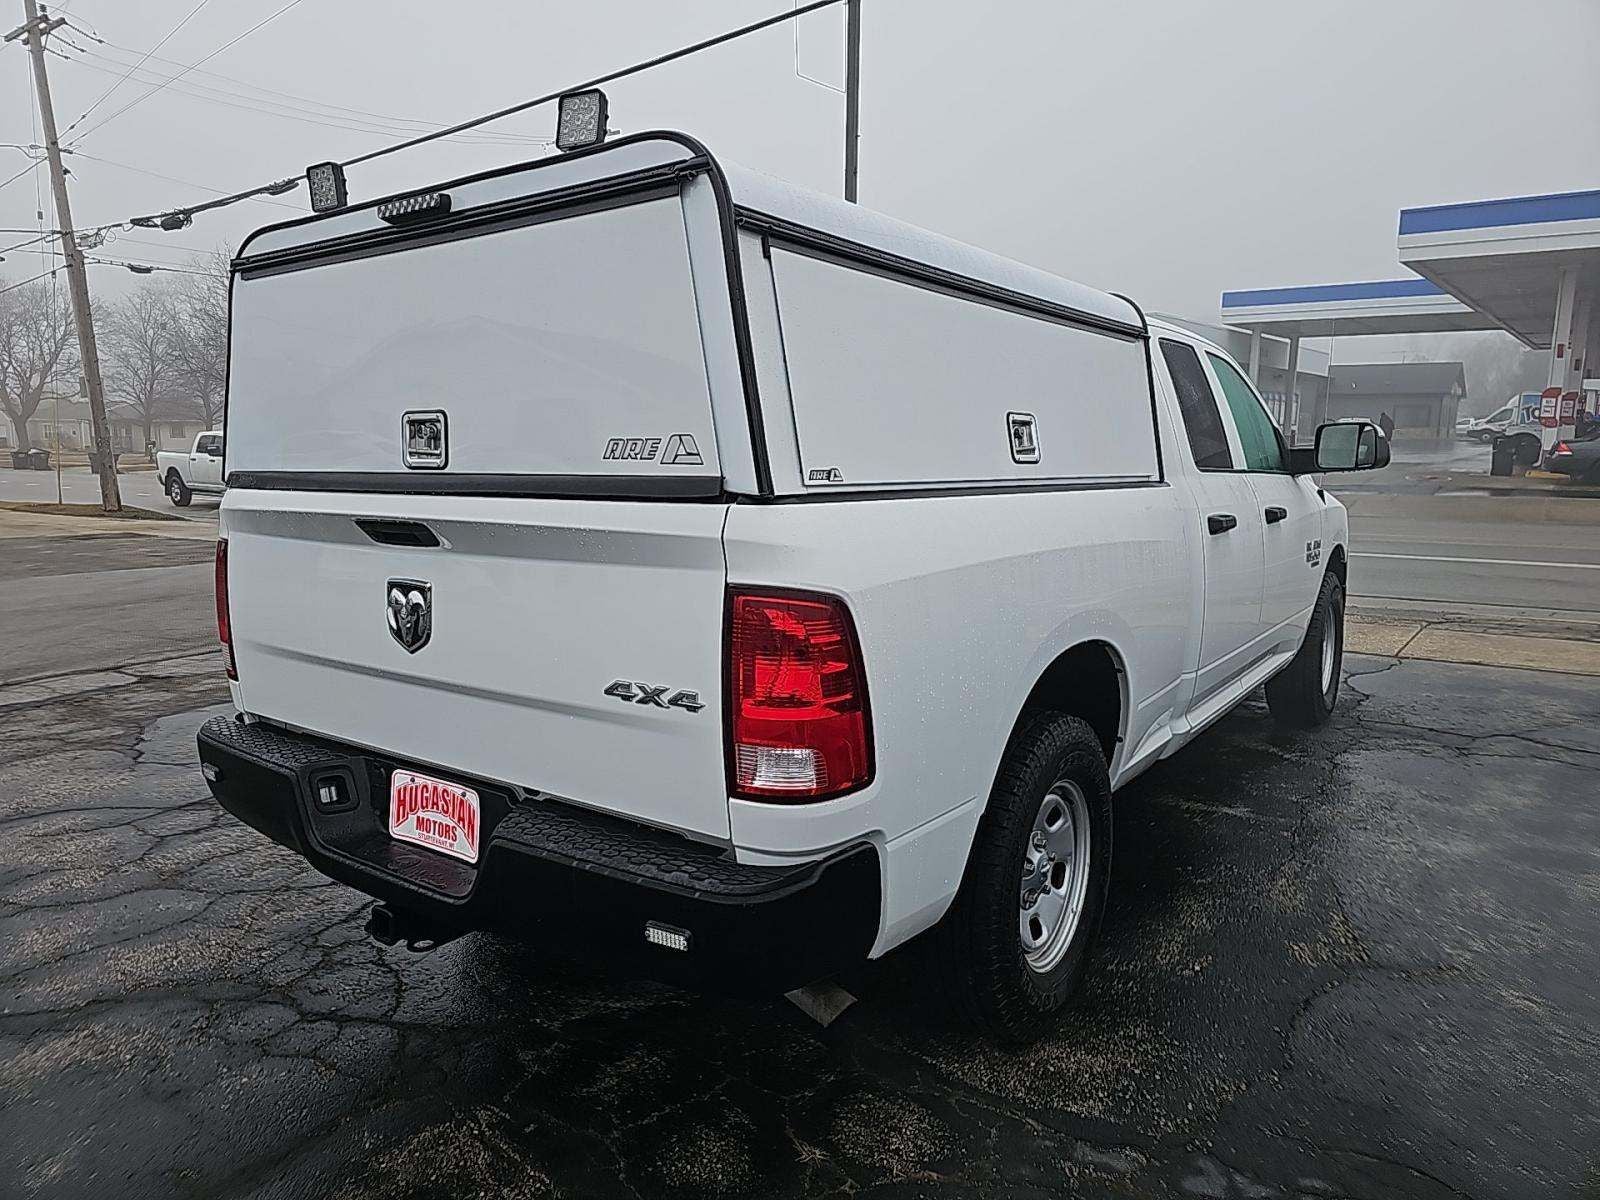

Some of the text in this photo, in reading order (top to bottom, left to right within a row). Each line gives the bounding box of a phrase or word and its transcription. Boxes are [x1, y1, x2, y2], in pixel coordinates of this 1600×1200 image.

[602, 437, 662, 460] ARE
[808, 469, 830, 481] ARE
[395, 784, 476, 848] HUGASIAN
[416, 815, 458, 843] MOTORS
